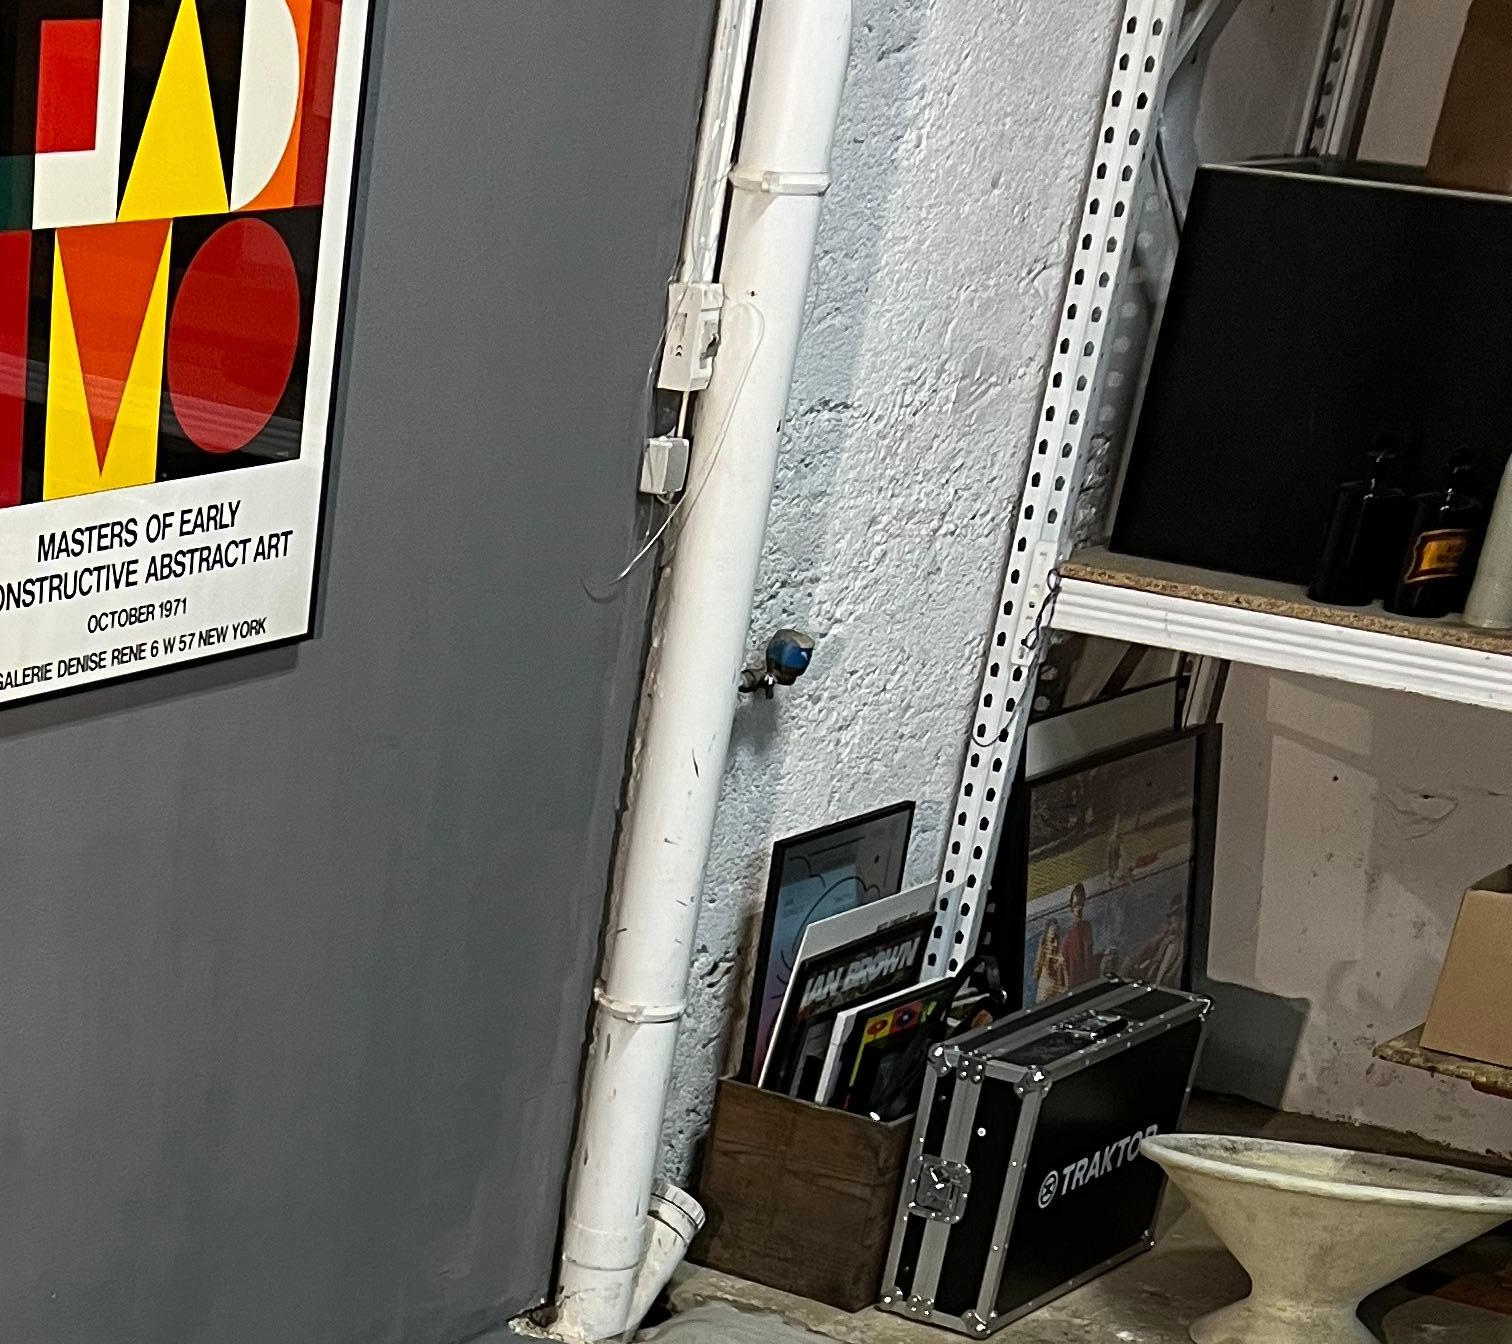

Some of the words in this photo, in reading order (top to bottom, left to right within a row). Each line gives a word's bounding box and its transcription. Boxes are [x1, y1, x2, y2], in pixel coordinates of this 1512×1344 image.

[37, 518, 138, 562] MASTERS
[146, 512, 174, 543] OF
[179, 500, 241, 537] EARLY
[145, 538, 251, 584] ABSTRACT
[253, 530, 293, 561] ART
[87, 603, 156, 634] OCTOBER
[159, 597, 187, 619] 1971
[57, 651, 107, 679] DENISE
[111, 642, 148, 667] RENE
[150, 641, 159, 658] 6
[163, 635, 176, 655] W
[178, 633, 195, 652] 57
[198, 625, 229, 648] NEW
[232, 617, 267, 641] YORK
